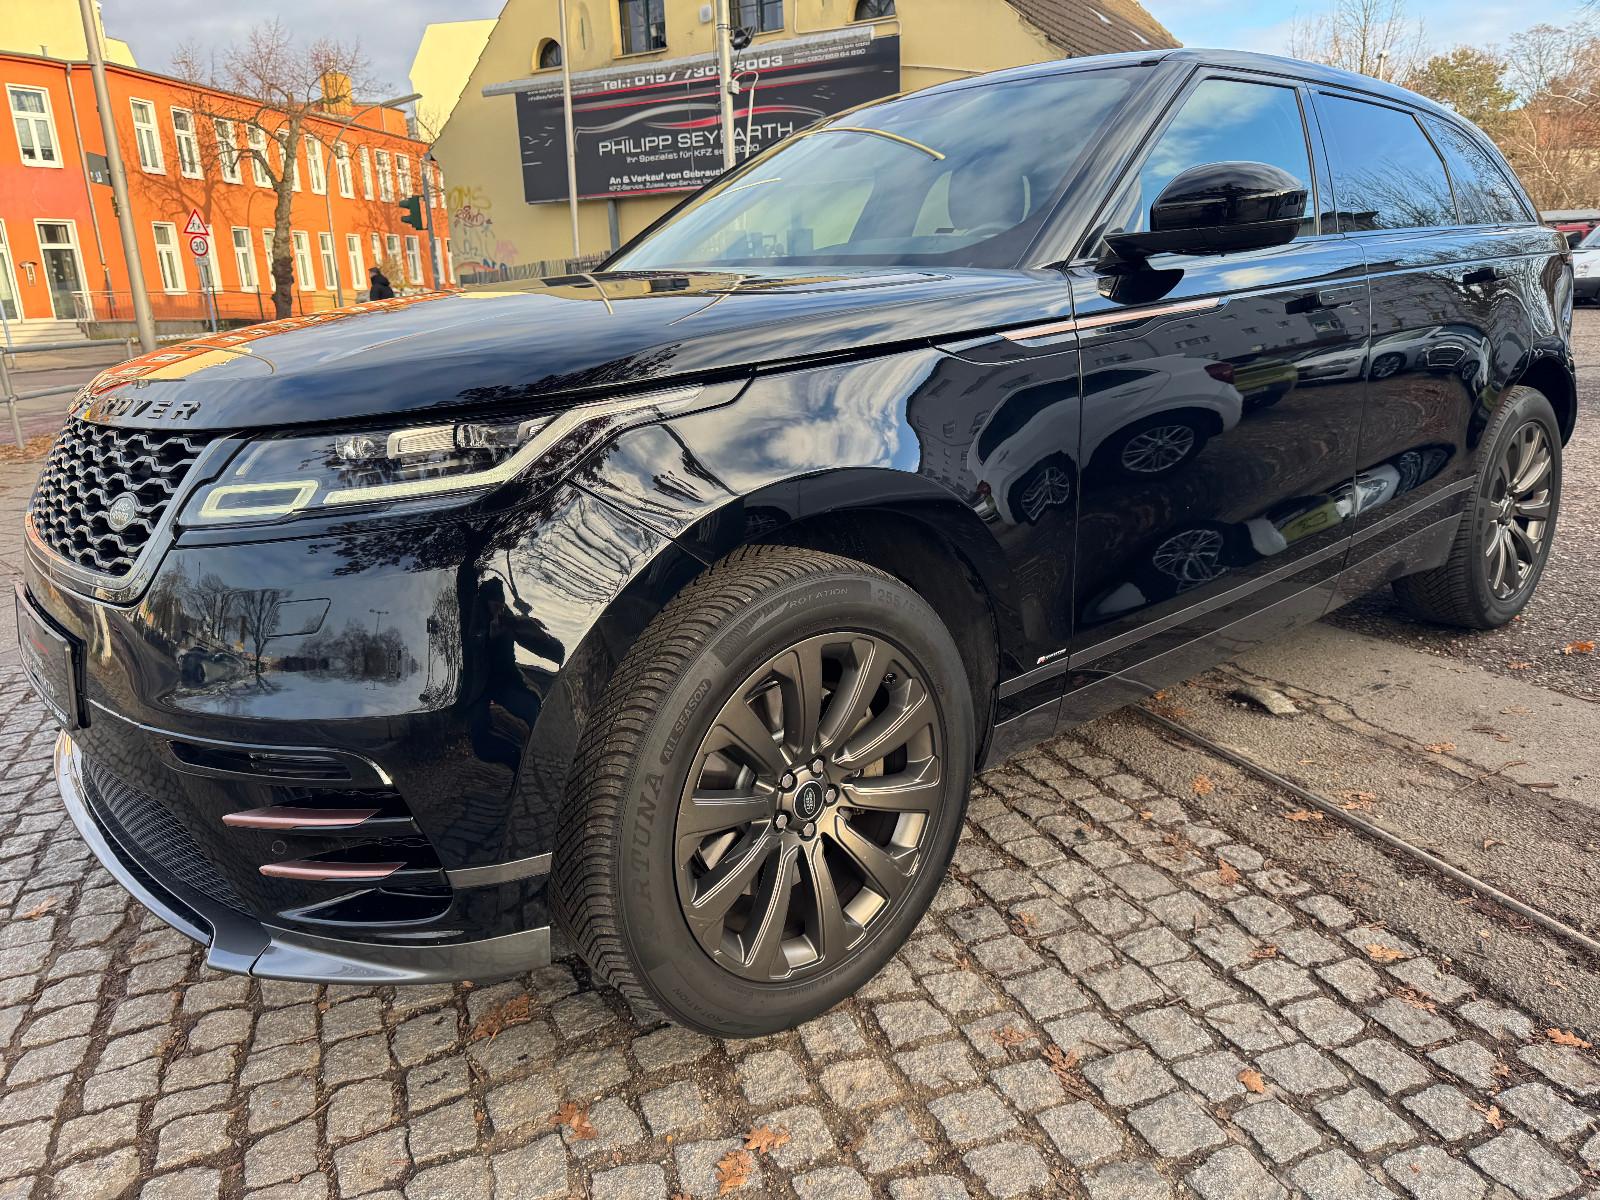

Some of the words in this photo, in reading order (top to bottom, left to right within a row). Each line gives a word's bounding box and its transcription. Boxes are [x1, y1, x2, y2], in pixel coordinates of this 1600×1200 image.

[601, 79, 631, 91] Tel.:
[733, 55, 783, 73] 2003
[599, 135, 672, 156] PHILIPP
[626, 156, 638, 164] Ihr
[680, 150, 693, 158] für
[694, 149, 713, 157] KFZ
[609, 176, 621, 185] An
[623, 175, 630, 183] &
[631, 172, 664, 183] Verkauf
[666, 171, 681, 180] von
[193, 240, 206, 252] 30
[789, 587, 848, 609] ROTATION
[663, 737, 679, 761] ALL
[675, 681, 710, 734] SEASON
